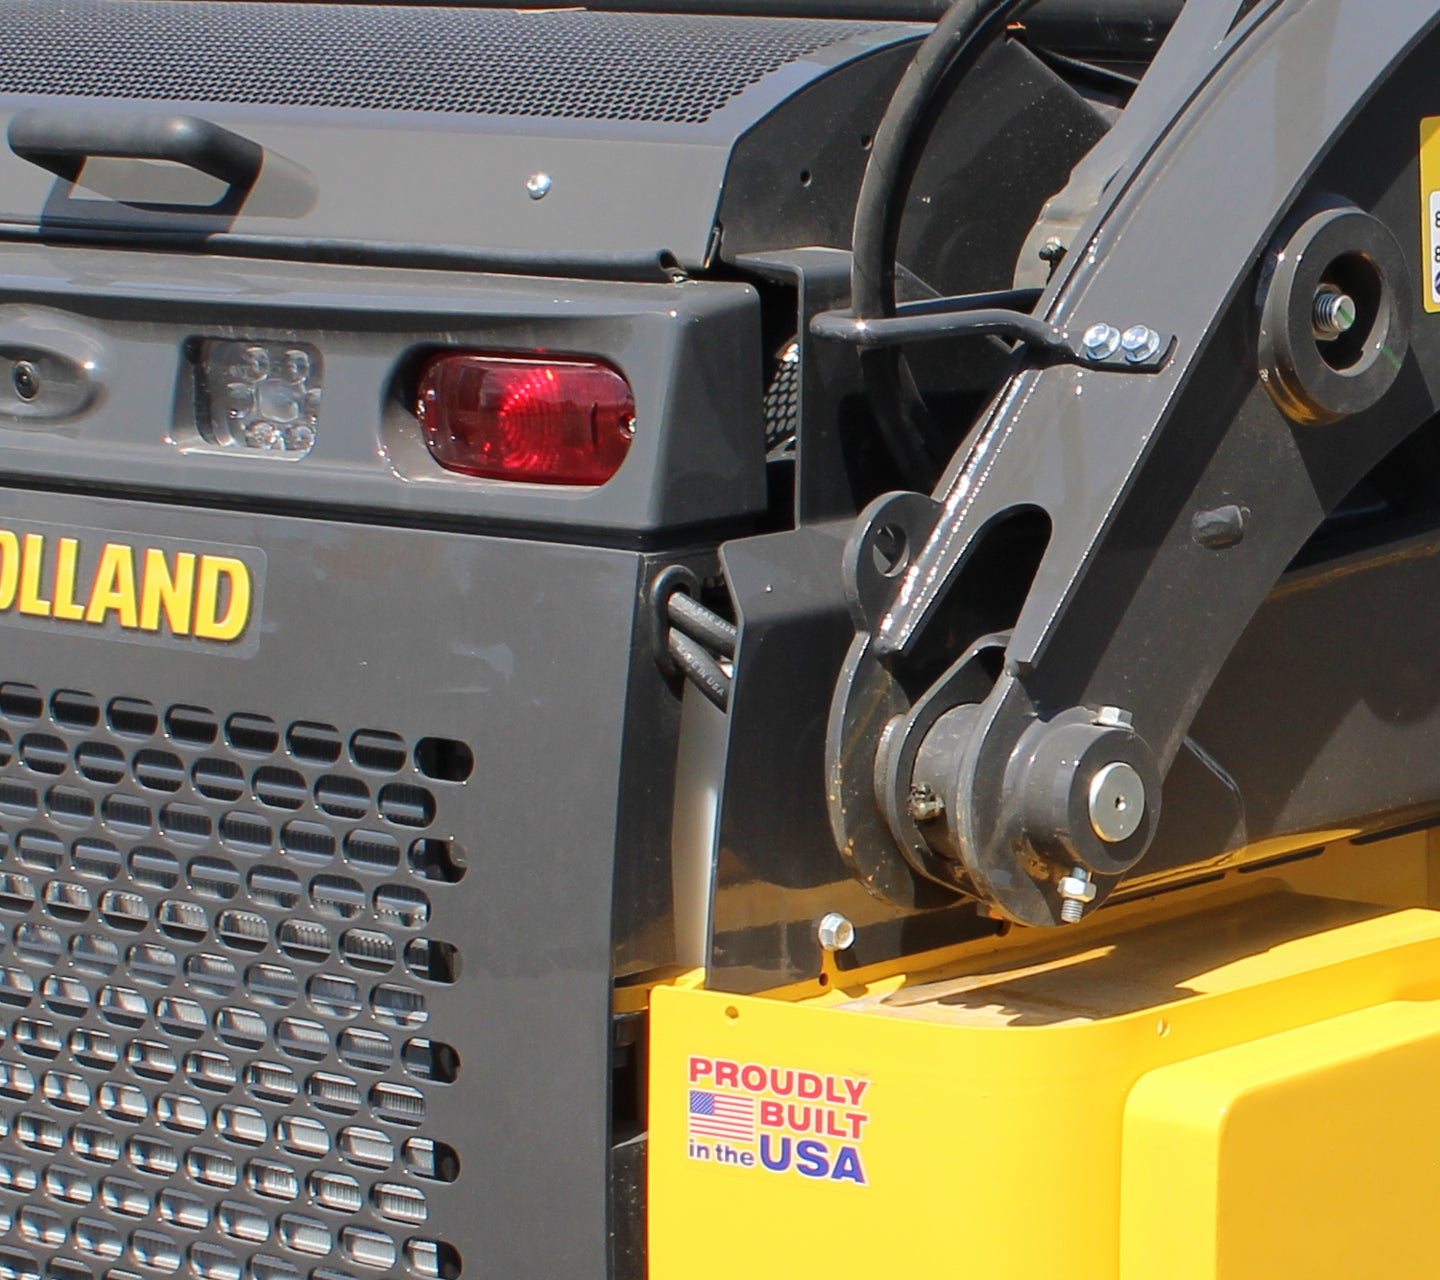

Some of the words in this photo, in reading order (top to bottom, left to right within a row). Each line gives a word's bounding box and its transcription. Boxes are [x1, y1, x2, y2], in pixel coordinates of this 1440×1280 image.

[688, 1056, 869, 1106] PROUDLY
[760, 1099, 869, 1140] BUILT
[688, 1138, 711, 1160] in
[715, 1140, 755, 1166] the
[759, 1133, 866, 1184] USA
